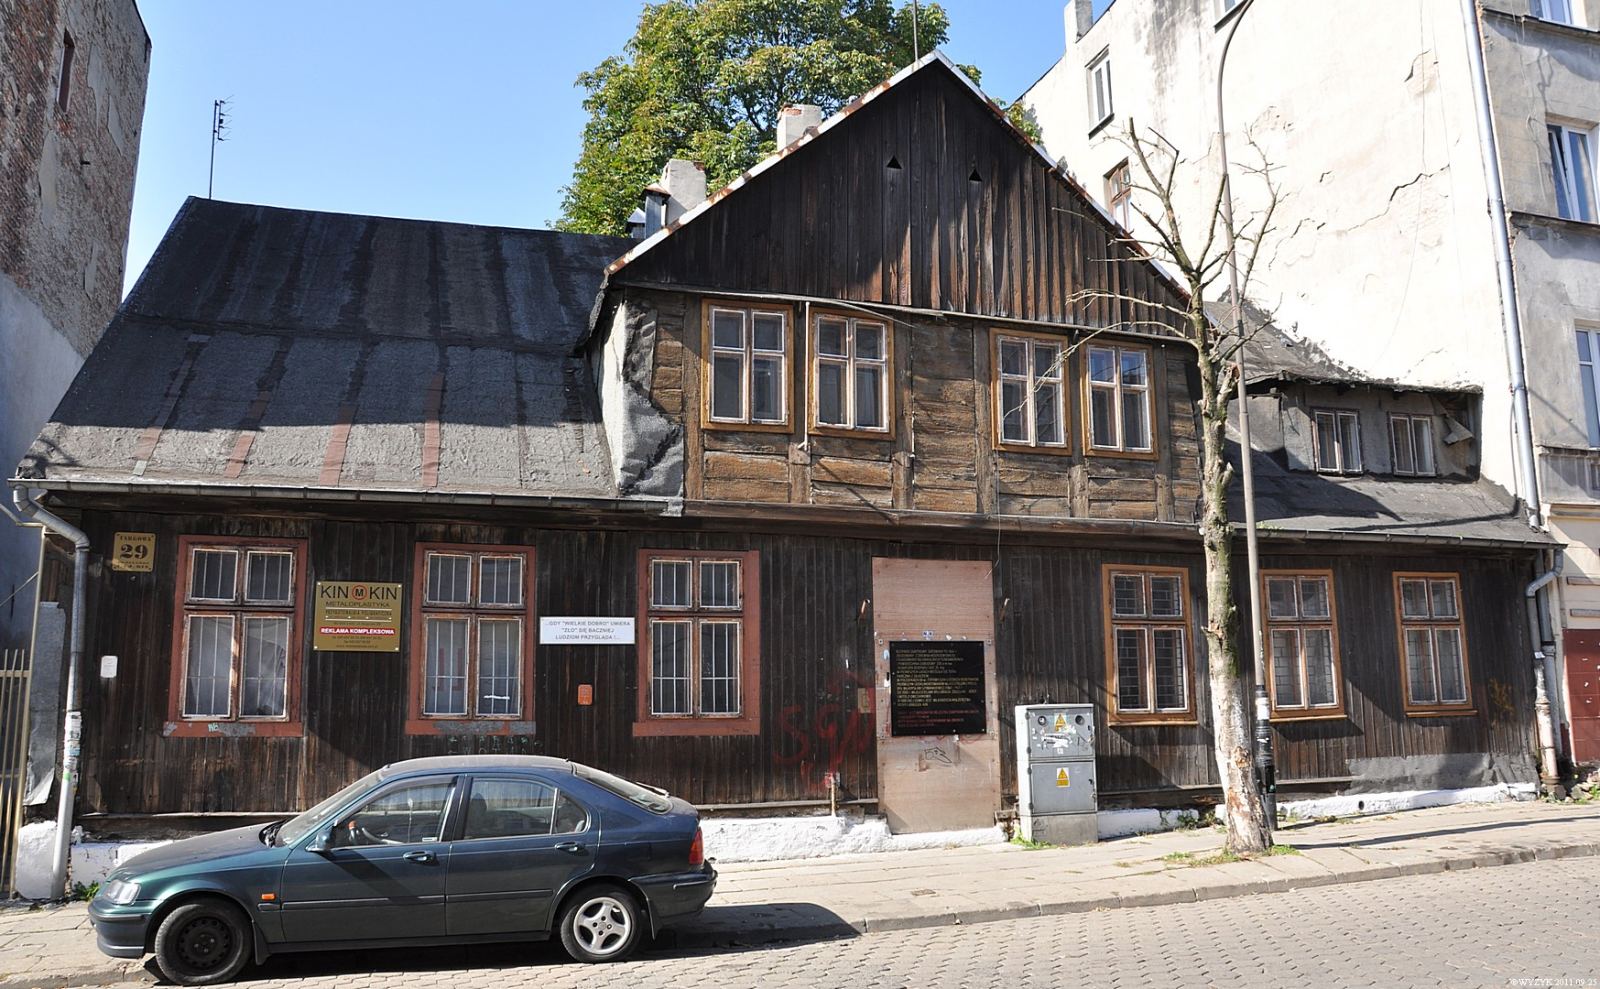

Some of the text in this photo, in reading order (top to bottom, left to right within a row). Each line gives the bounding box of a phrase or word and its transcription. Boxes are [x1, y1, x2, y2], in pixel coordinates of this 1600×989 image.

[120, 543, 148, 559] 29
[320, 585, 349, 599] KIN
[369, 586, 397, 600] KIN
[321, 627, 395, 636] REKLAMA KOMPLEKSOWA
